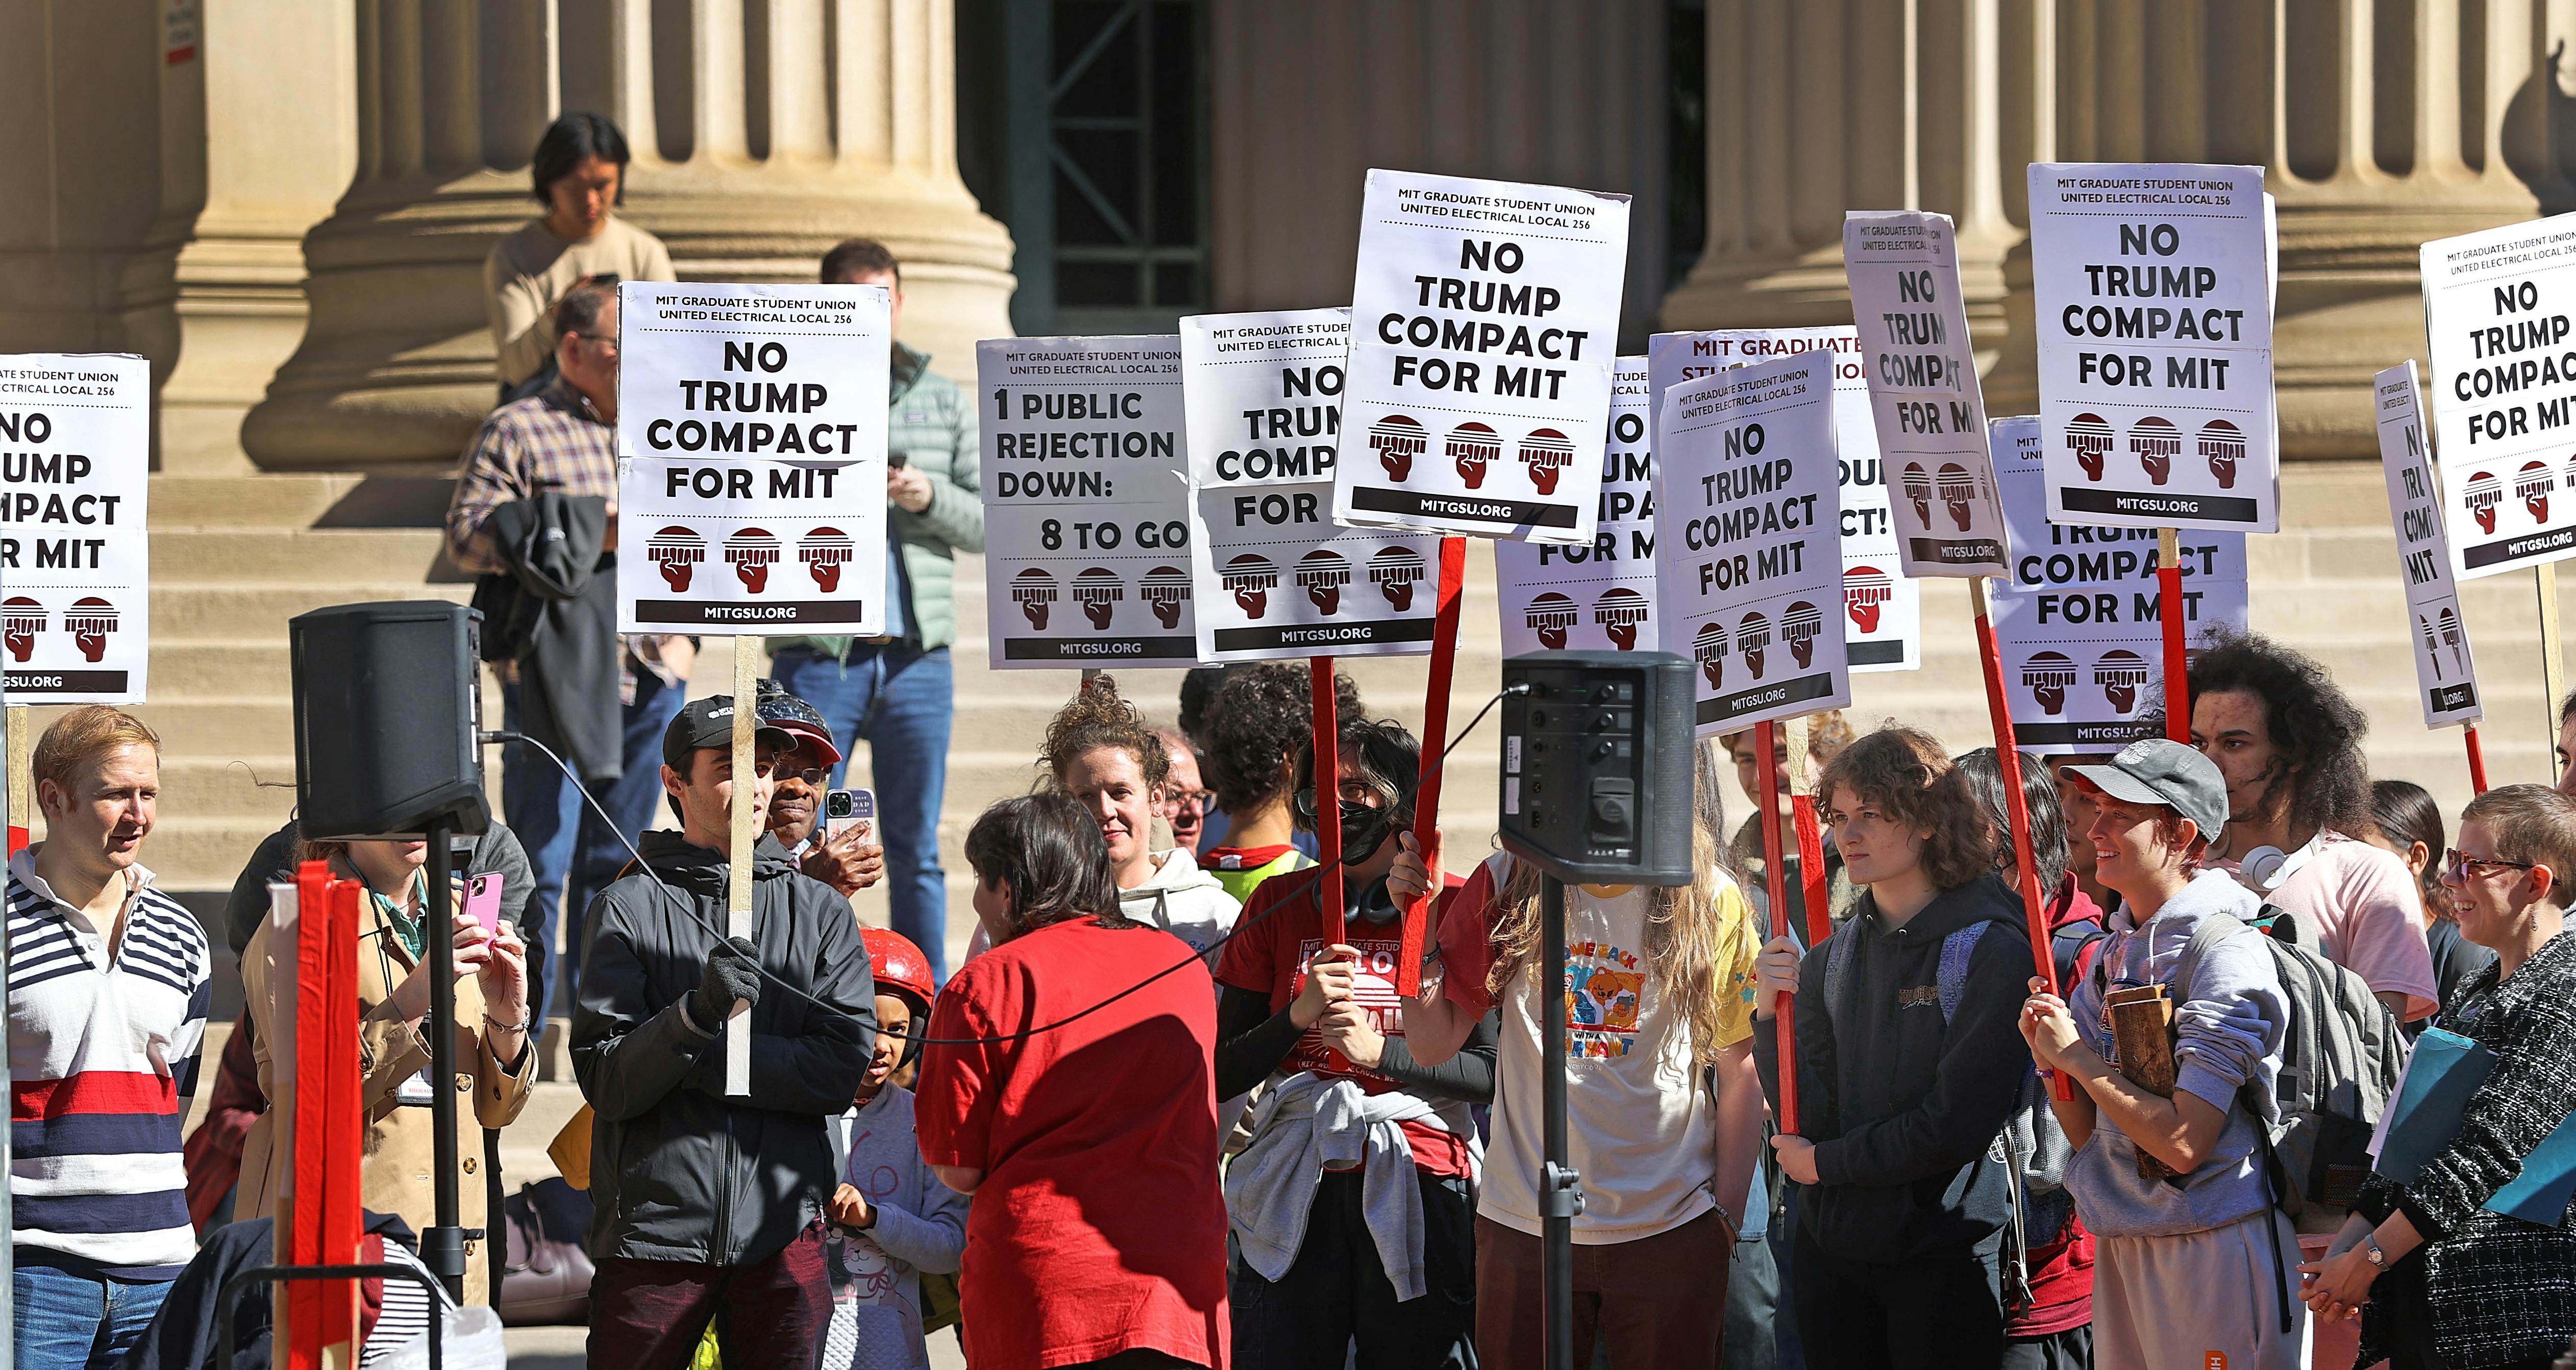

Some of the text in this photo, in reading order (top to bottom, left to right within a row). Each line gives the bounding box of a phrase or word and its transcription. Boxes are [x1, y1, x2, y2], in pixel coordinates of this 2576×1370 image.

[2058, 179, 2233, 191] MIT GRADUATE STUDENT UNION
[2061, 194, 2231, 205] UNITED ELECTRICAL LOCAL 256
[1398, 189, 1595, 215] MIT GRADUATE STUDENT UNION
[1401, 204, 1590, 229] UNITED ELECTRICAL LOCAL 256
[1863, 241, 1886, 250] UNITED
[1888, 241, 1927, 250] ELECTRICAL
[1872, 227, 1906, 235] GRADUATE
[2120, 223, 2179, 256] NO
[1460, 239, 1524, 273] NO
[2448, 231, 2576, 262] MIT GRADUATE STUDENT UNION
[2451, 245, 2576, 275] UNITED ELECTRICAL LOCAL 256
[1415, 276, 1561, 317] TRUMP
[1898, 270, 1935, 303] NO
[2085, 265, 2216, 298] TRUMP
[656, 296, 856, 310] MIT GRADUATE STUDENT UNION
[2494, 281, 2538, 315] NO
[660, 310, 852, 323] UNITED ELECTRICAL LOCAL 256
[1213, 323, 1350, 338] MIT GRADUATE STUDE
[2063, 305, 2243, 341] COMPACT
[1218, 341, 1265, 352] UNITED
[1268, 338, 1341, 350] ELECTRICAL
[1379, 313, 1588, 360] COMPACT
[1694, 340, 1733, 356] MIT
[2470, 315, 2570, 358] TRUMP
[724, 341, 787, 373] NO
[1006, 352, 1181, 361] MIT GRADUATE STUDENT UNION
[1010, 364, 1178, 375] UNITED ELECTRICAL LOCAL 256
[2079, 353, 2230, 390] FOR MIT
[0, 384, 49, 393] CTRICAL
[54, 386, 93, 394] LOCAL
[20, 371, 75, 380] STUDENT
[79, 373, 118, 382] UNION
[1283, 365, 1344, 397] NO
[1393, 355, 1566, 400] FOR MIT
[1613, 372, 1649, 381] TUDE
[1679, 369, 1808, 406] MIT GRADUATE STUDENT UNION
[2387, 381, 2408, 394] GRADUATE
[680, 380, 827, 413] TRUMP
[994, 388, 1142, 419] 1 PUBLIC
[1682, 384, 1806, 419] UNITED ELECTRICAL LOCAL 256
[2383, 399, 2396, 410] UNITED
[0, 412, 51, 443] NO
[1897, 402, 1944, 434] FOR
[2469, 407, 2529, 444] FOR
[647, 419, 857, 454] COMPACT
[997, 432, 1174, 462] REJECTION
[1724, 423, 1765, 460] NO
[2017, 438, 2037, 446] MIT
[1216, 445, 1335, 481] COMP
[666, 468, 838, 499] FOR MIT
[998, 471, 1112, 497] DOWN:
[1702, 458, 1792, 506] TRUMP
[1234, 493, 1318, 526] FOR
[1421, 500, 1512, 517] MITGSU.ORG
[2117, 497, 2198, 512] MITGSU.ORG
[1042, 518, 1188, 550] 8 TO GO
[1686, 494, 1817, 551] COMPACT
[36, 539, 105, 568] MIT
[1941, 545, 1995, 557] MITGSU.ORG
[2508, 532, 2573, 555] MITGSU.ORG
[1699, 540, 1805, 595] FOR MIT
[2406, 549, 2438, 585] MIT
[705, 607, 797, 619] MITGSU.ORG
[2038, 591, 2203, 624] FOR MT
[1060, 642, 1142, 654] MITGSU.ORG
[1281, 628, 1372, 642] MITGSU.ORG
[1731, 688, 1786, 711] MITGSU.ORG
[1304, 942, 1320, 951] MIT
[1598, 944, 1638, 970] BACK
[1351, 1065, 1379, 1079] ECAUSE
